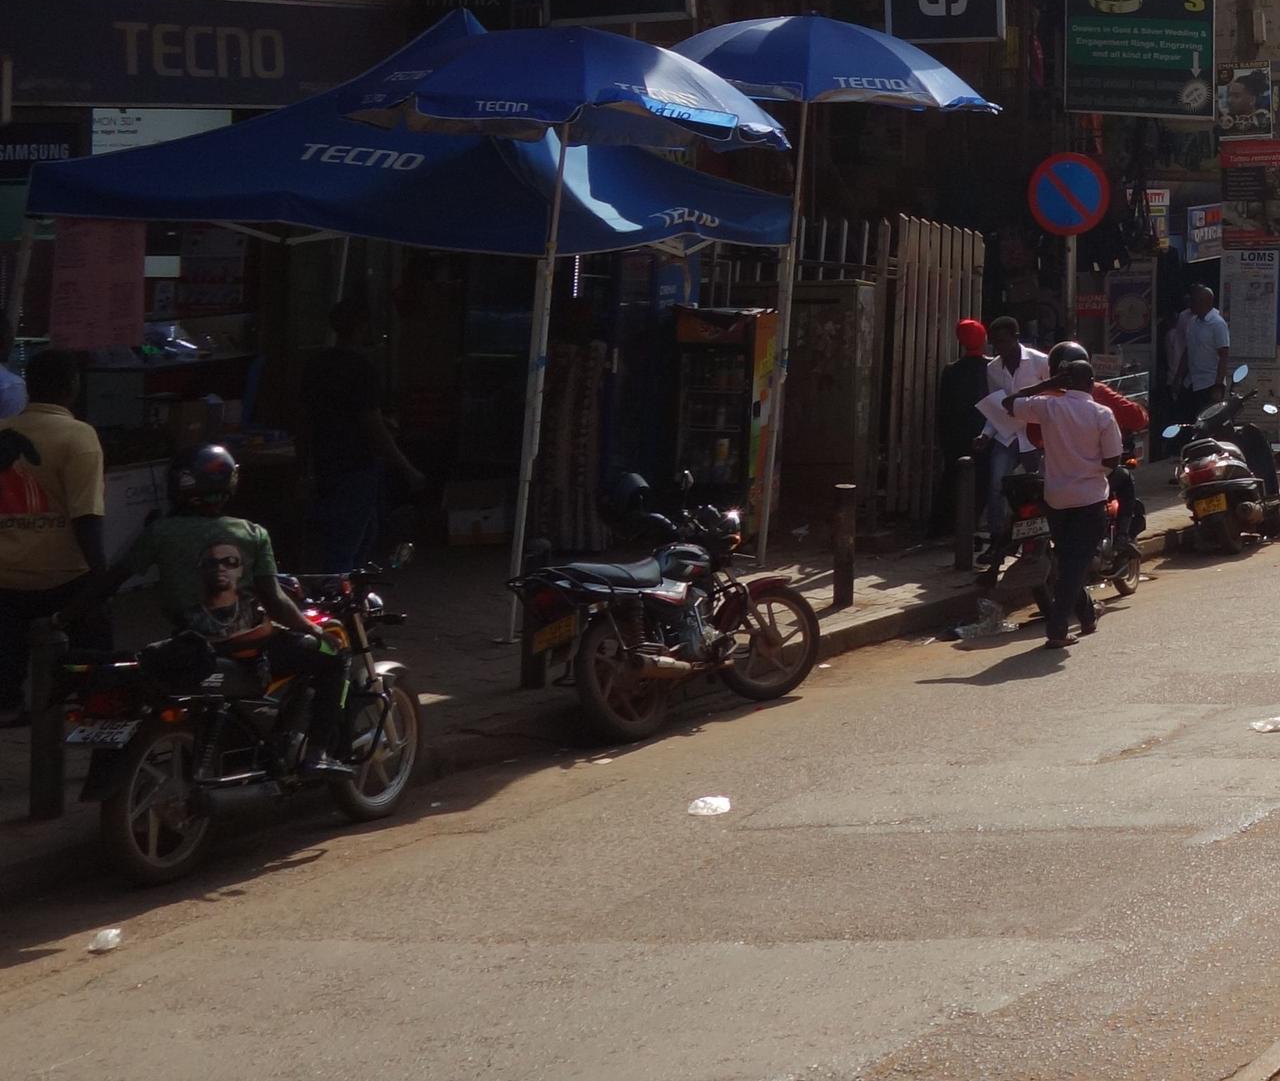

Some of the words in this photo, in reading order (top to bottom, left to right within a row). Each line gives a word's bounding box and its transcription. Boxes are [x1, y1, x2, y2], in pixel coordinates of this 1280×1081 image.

[1165, 27, 1199, 39] Wedding
[113, 22, 286, 79] TECNO
[1160, 40, 1203, 51] Engraving
[834, 76, 908, 91] TECNO
[302, 143, 426, 170] TECNO
[1240, 251, 1274, 262] LOMS
